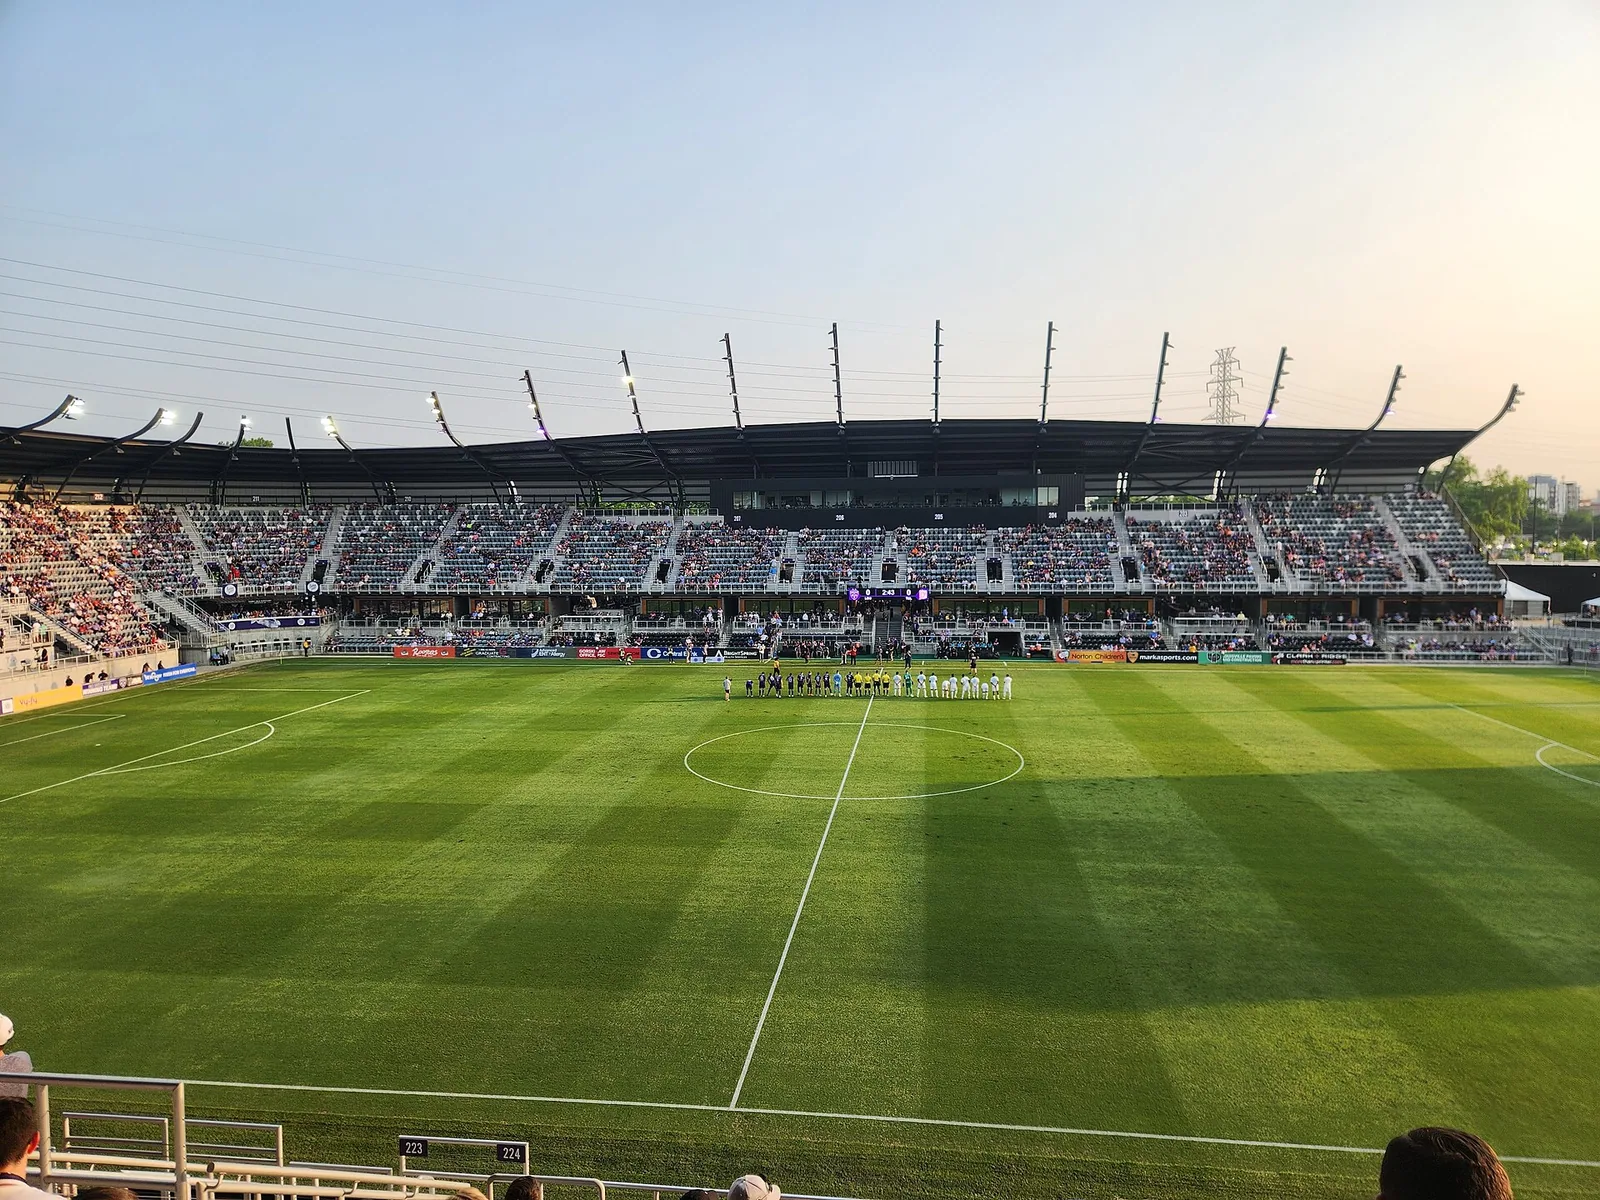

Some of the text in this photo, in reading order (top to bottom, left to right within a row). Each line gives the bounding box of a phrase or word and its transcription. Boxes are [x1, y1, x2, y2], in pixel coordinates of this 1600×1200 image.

[1094, 652, 1125, 660] Children's
[1139, 654, 1198, 662] markasports.com
[405, 1142, 423, 1154] 223
[503, 1147, 521, 1160] 224
